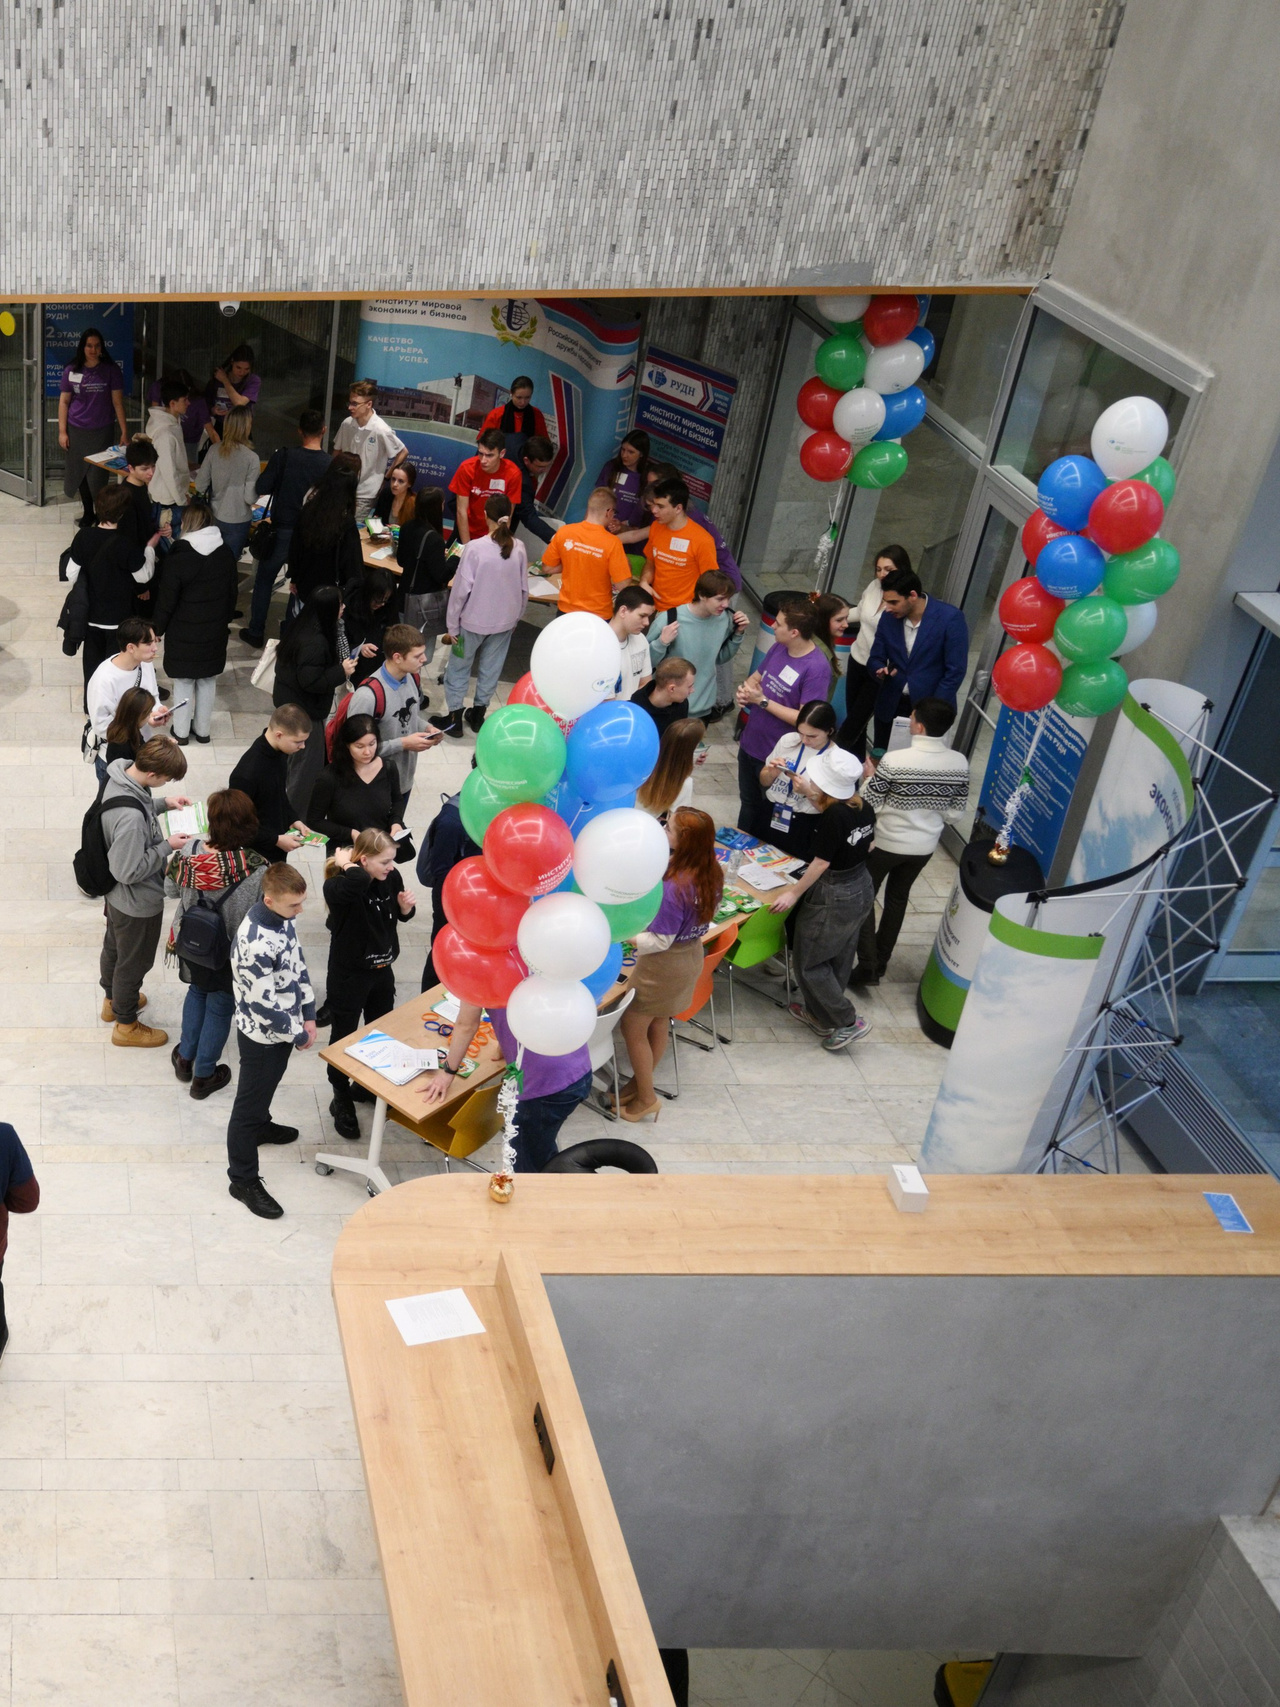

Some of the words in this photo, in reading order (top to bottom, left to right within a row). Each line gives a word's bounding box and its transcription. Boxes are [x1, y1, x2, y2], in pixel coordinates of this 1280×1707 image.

[45, 303, 94, 311] КОМИССИЯ
[421, 301, 462, 311] мировой
[368, 306, 418, 315] экономики
[429, 310, 467, 321] бизнеса
[46, 326, 55, 338] 2
[367, 336, 414, 345] КАЧЕСТВО
[383, 345, 423, 355] КАРЬЕРА
[399, 355, 429, 364] УСПЕХ
[670, 379, 696, 397] РУДН
[649, 404, 681, 423] ИНСТИТУТ
[681, 418, 715, 437] МИРОВОЙ
[642, 410, 682, 433] ЭКОНОМИКИ
[688, 431, 718, 449] БИЗНЕСА
